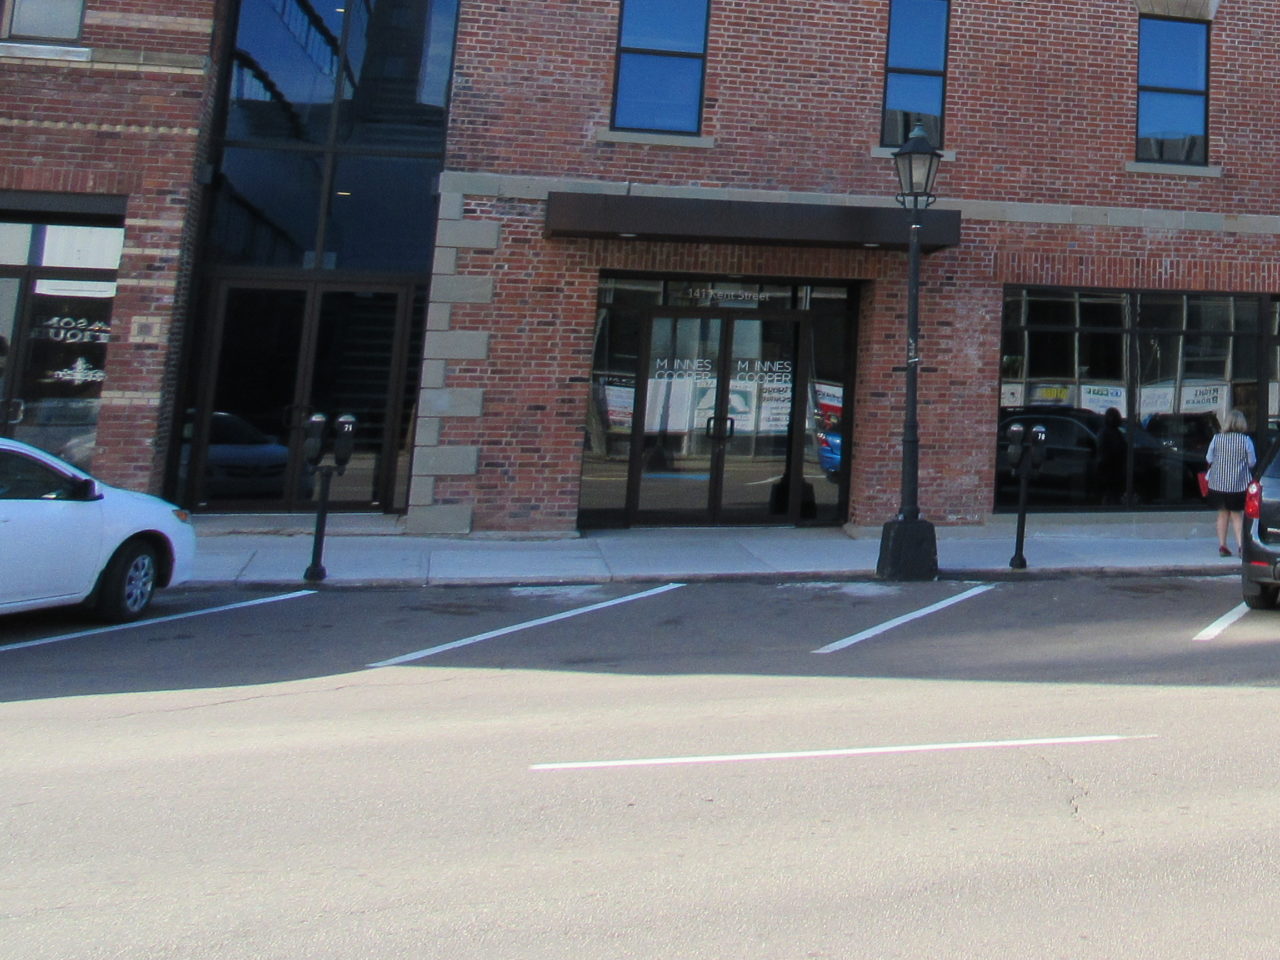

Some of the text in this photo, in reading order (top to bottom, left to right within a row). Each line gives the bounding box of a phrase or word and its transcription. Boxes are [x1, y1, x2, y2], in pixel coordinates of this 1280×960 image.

[737, 289, 770, 301] Street
[655, 370, 711, 380] COOPER
[736, 372, 792, 384] COOPER
